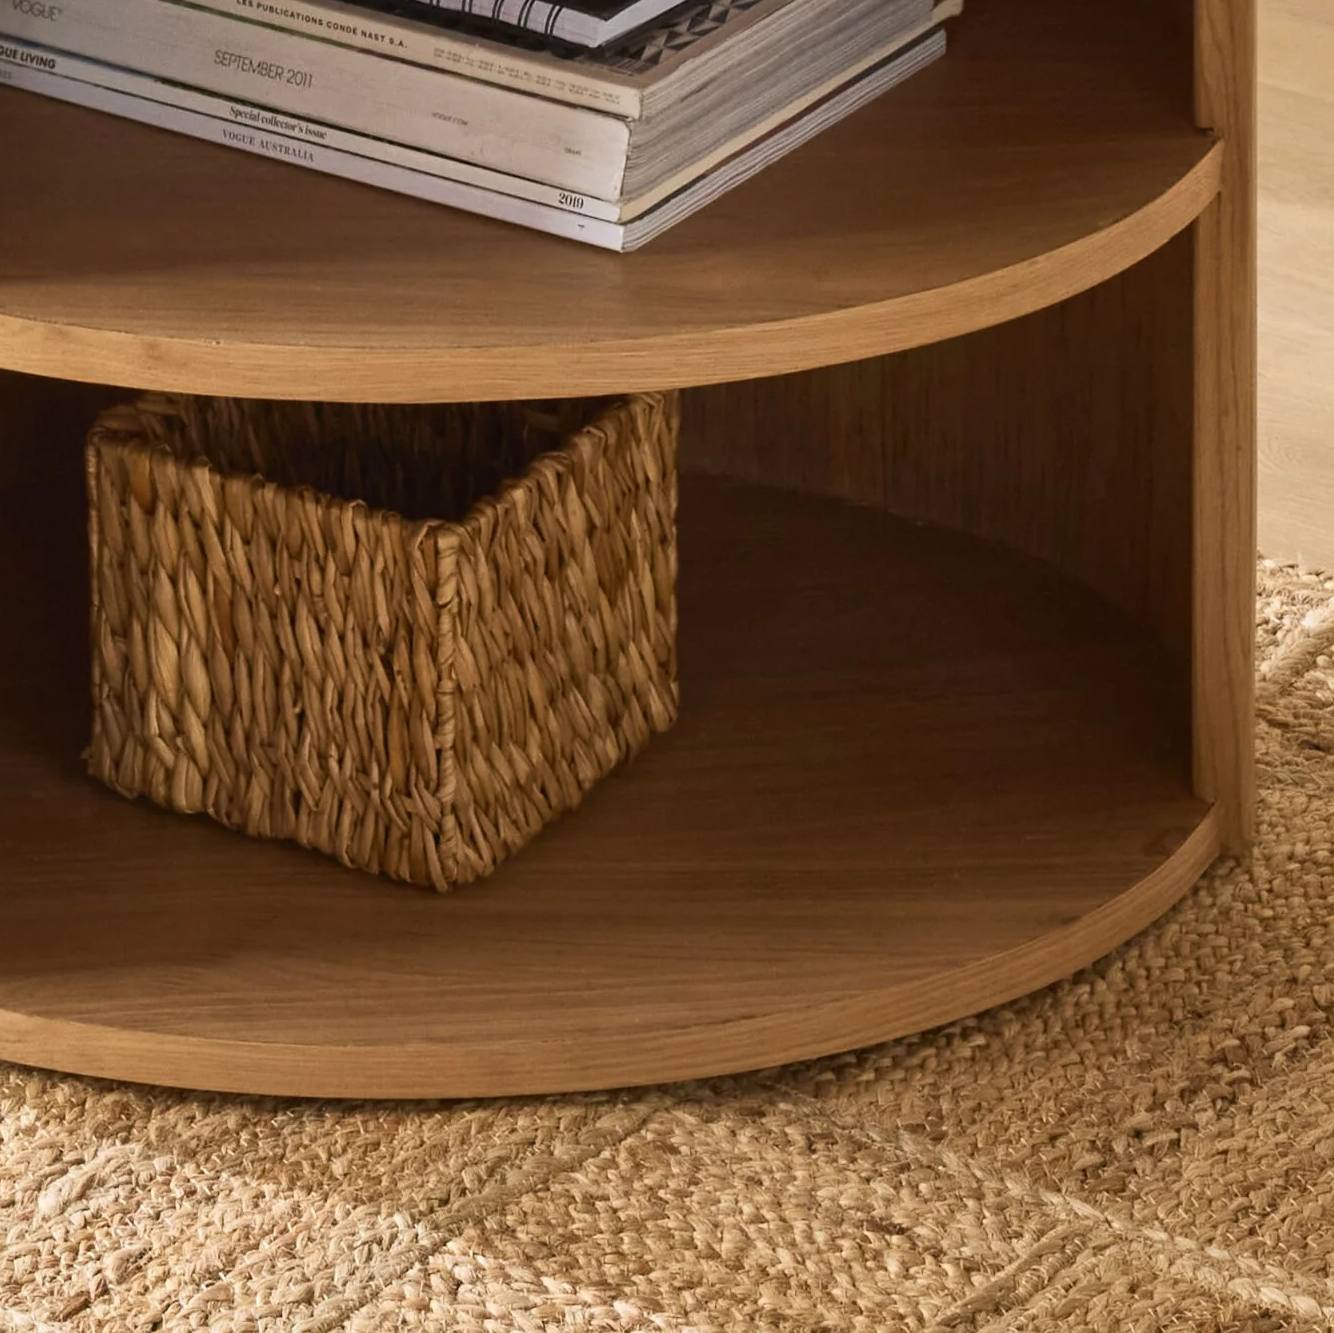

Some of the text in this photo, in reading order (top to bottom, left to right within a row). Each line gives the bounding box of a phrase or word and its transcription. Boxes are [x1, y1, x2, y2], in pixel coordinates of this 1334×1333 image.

[256, 2, 324, 26] PUBLICATIONS
[361, 30, 386, 43] NAST
[389, 37, 408, 49] S.A.
[20, 51, 56, 70] LIVING
[213, 49, 313, 88] SEPTEMBER 2011
[230, 105, 260, 123] Special
[305, 124, 327, 141] issue
[222, 129, 314, 162] VOGUE AUSTRALIA
[558, 191, 584, 210] 2019
